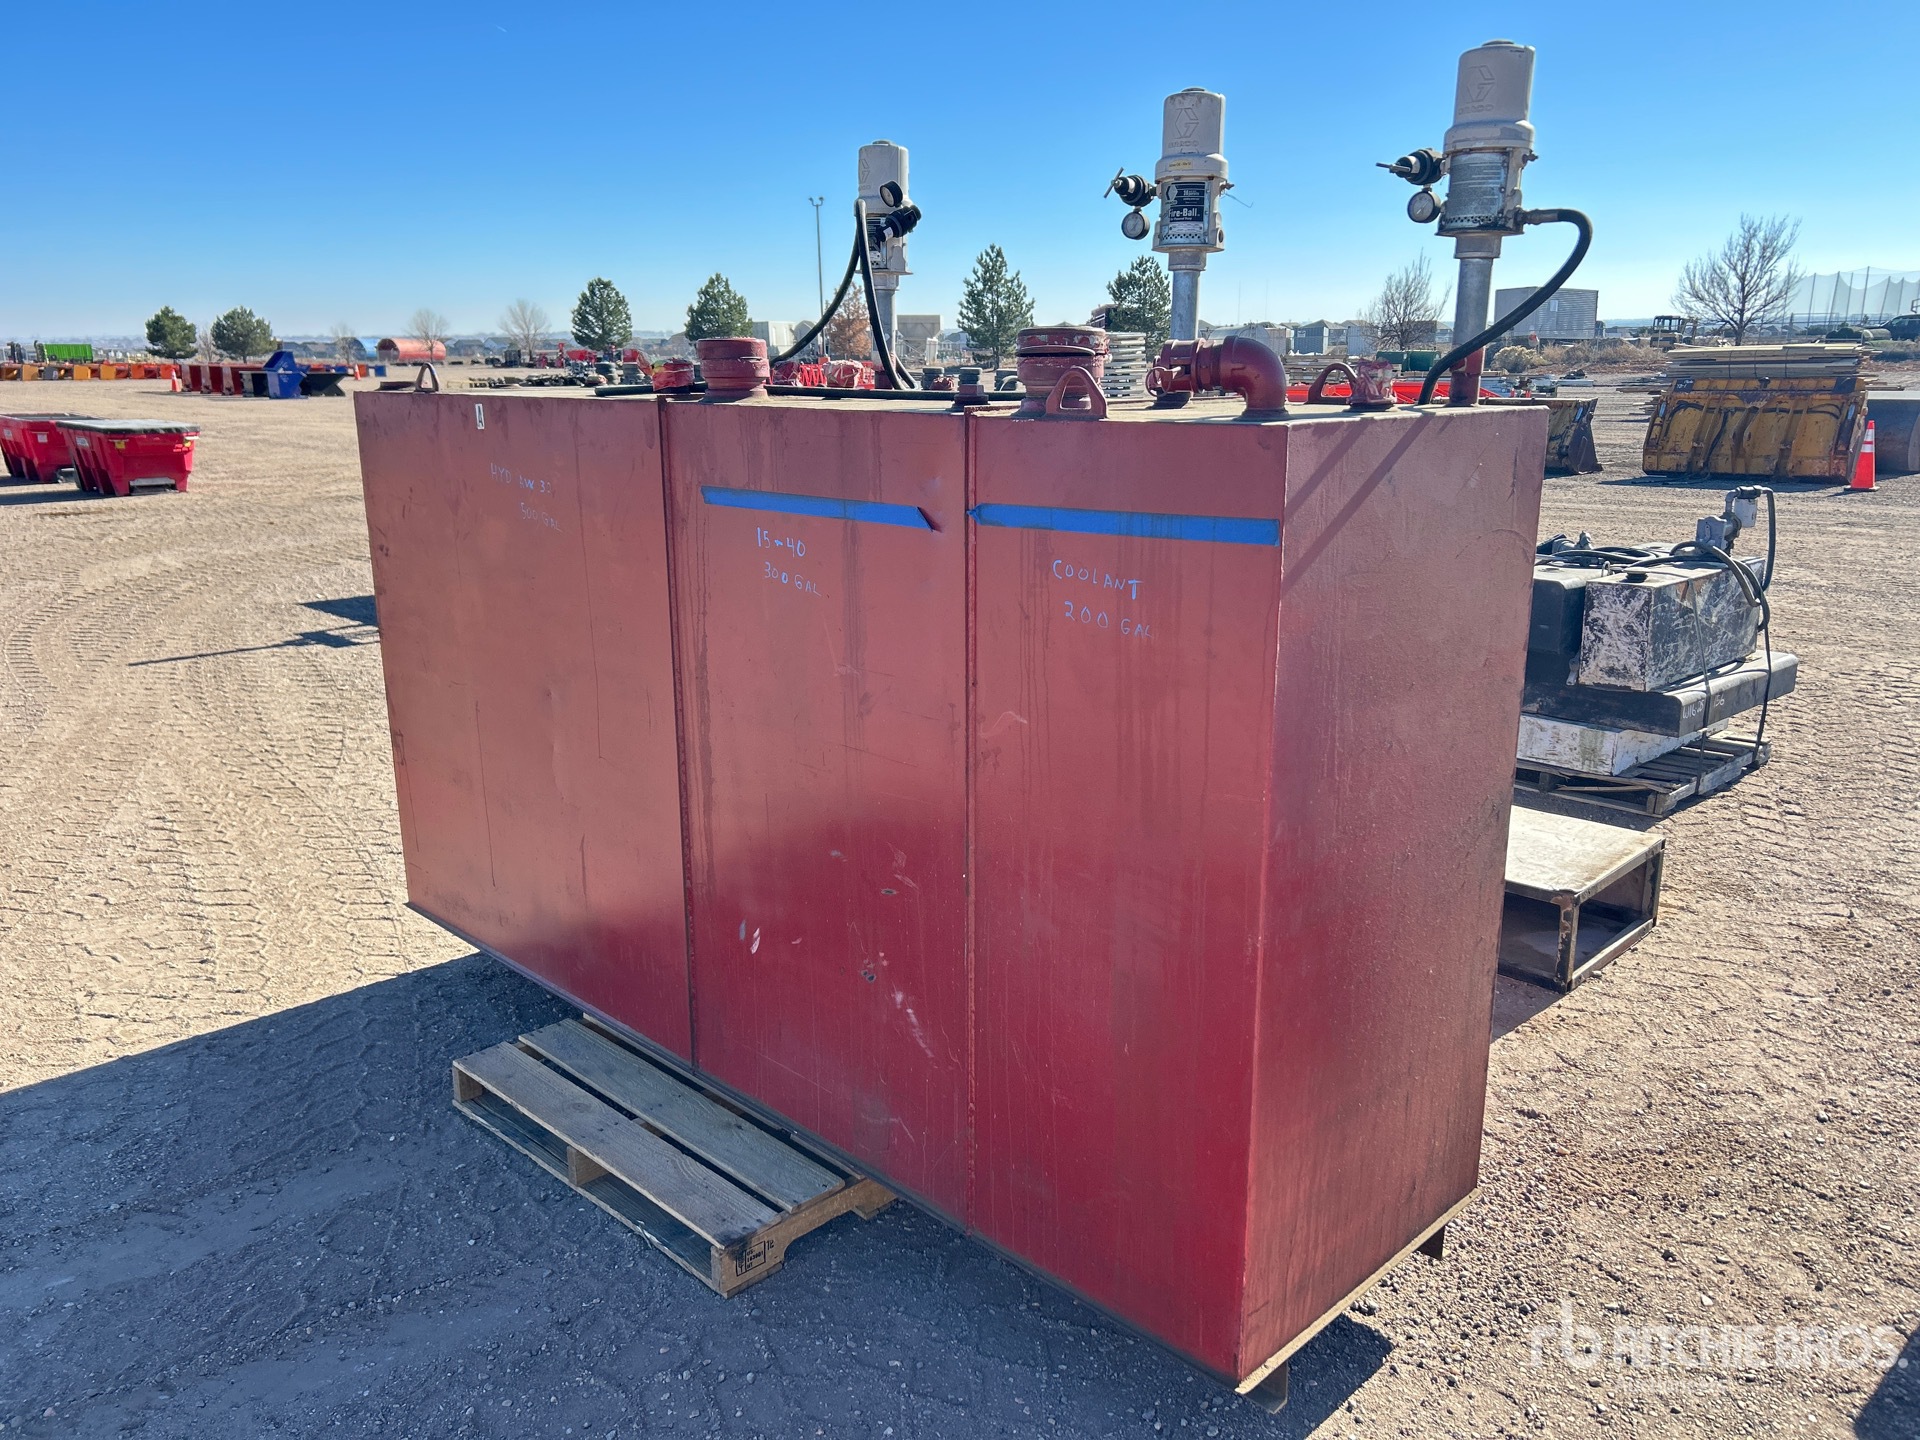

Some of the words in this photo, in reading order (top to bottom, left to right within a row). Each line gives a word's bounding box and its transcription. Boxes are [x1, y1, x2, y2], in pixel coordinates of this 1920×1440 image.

[1168, 207, 1198, 217] Fire-Ball
[490, 462, 511, 484] HYD
[520, 502, 537, 520] 500
[541, 511, 563, 533] GAL
[756, 526, 806, 558] 15-40
[764, 561, 788, 584] 300
[794, 574, 822, 597] GAL
[1052, 559, 1143, 600] COOLANT
[1064, 600, 1109, 629] 200
[1120, 618, 1152, 638] GAL
